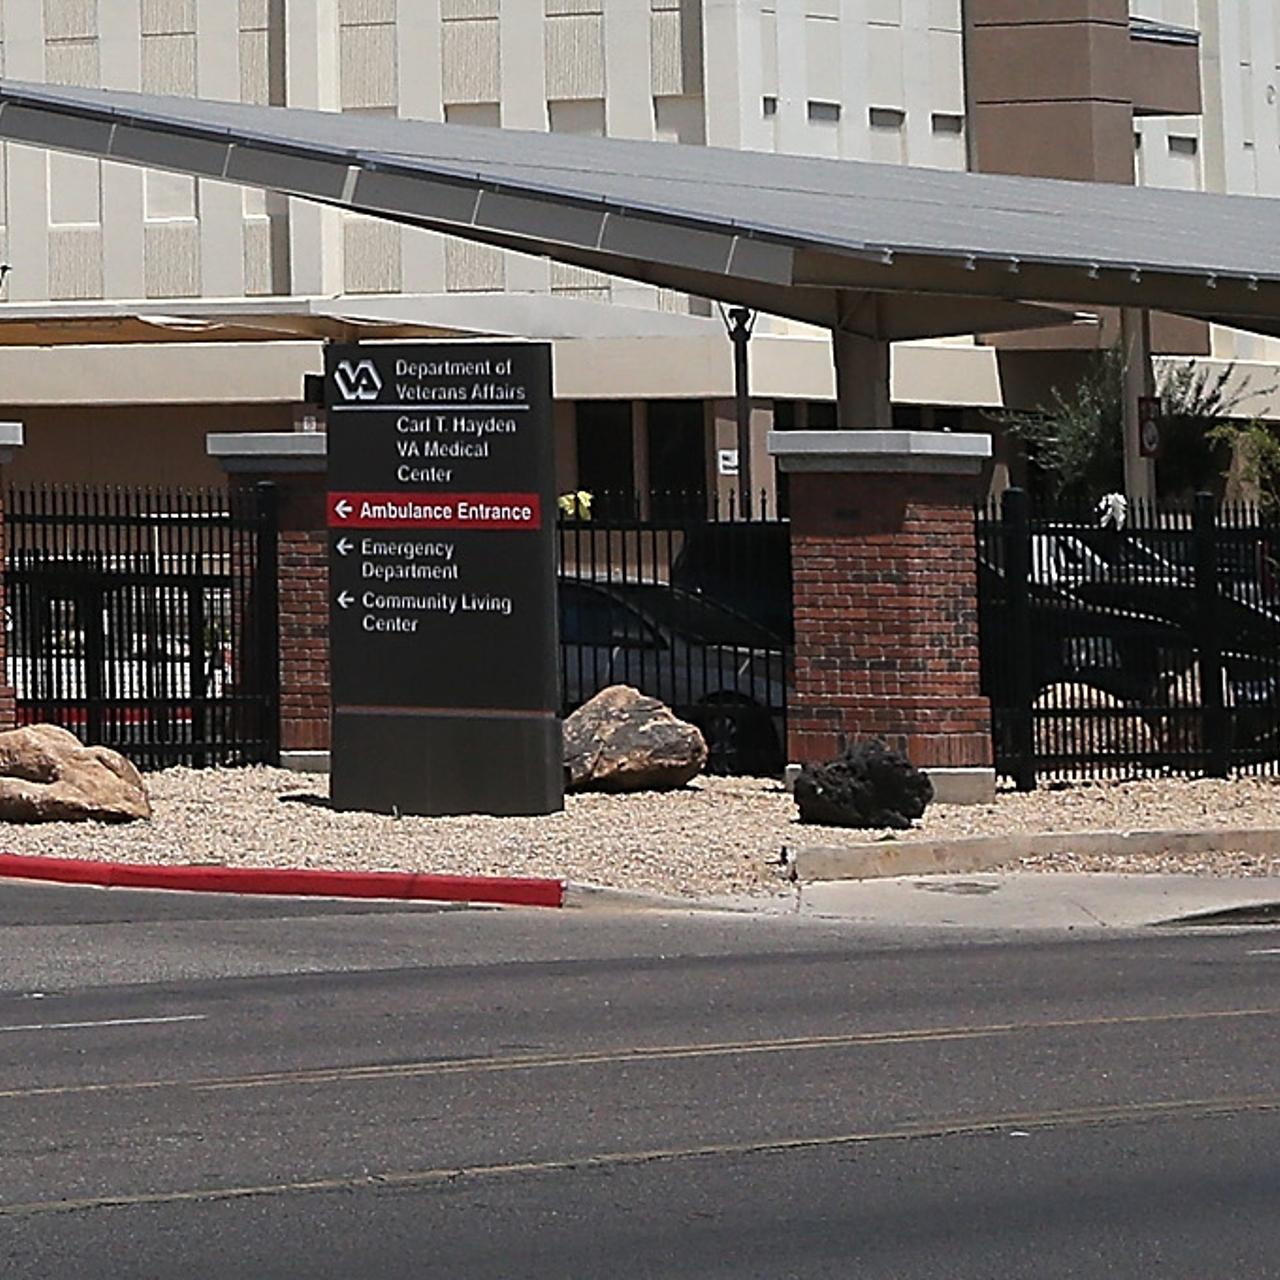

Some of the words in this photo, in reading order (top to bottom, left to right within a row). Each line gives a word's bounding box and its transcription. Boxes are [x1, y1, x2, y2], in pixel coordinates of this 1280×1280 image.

[396, 359, 490, 379] Department
[495, 359, 512, 376] of
[334, 359, 382, 400] VA
[396, 384, 467, 401] Veterans
[471, 383, 525, 400] Affairs
[396, 416, 430, 433] Carl
[435, 417, 449, 432] T.
[452, 416, 516, 437] Hayden
[397, 442, 420, 456] VA
[424, 441, 488, 457] Medical
[397, 465, 452, 482] Center
[360, 502, 452, 520] Ambulance
[457, 502, 531, 520] Entrance
[361, 538, 454, 559] Emergency
[362, 562, 459, 582] Department
[362, 592, 456, 613] Community
[461, 591, 512, 613] Living
[363, 615, 418, 632] Center
